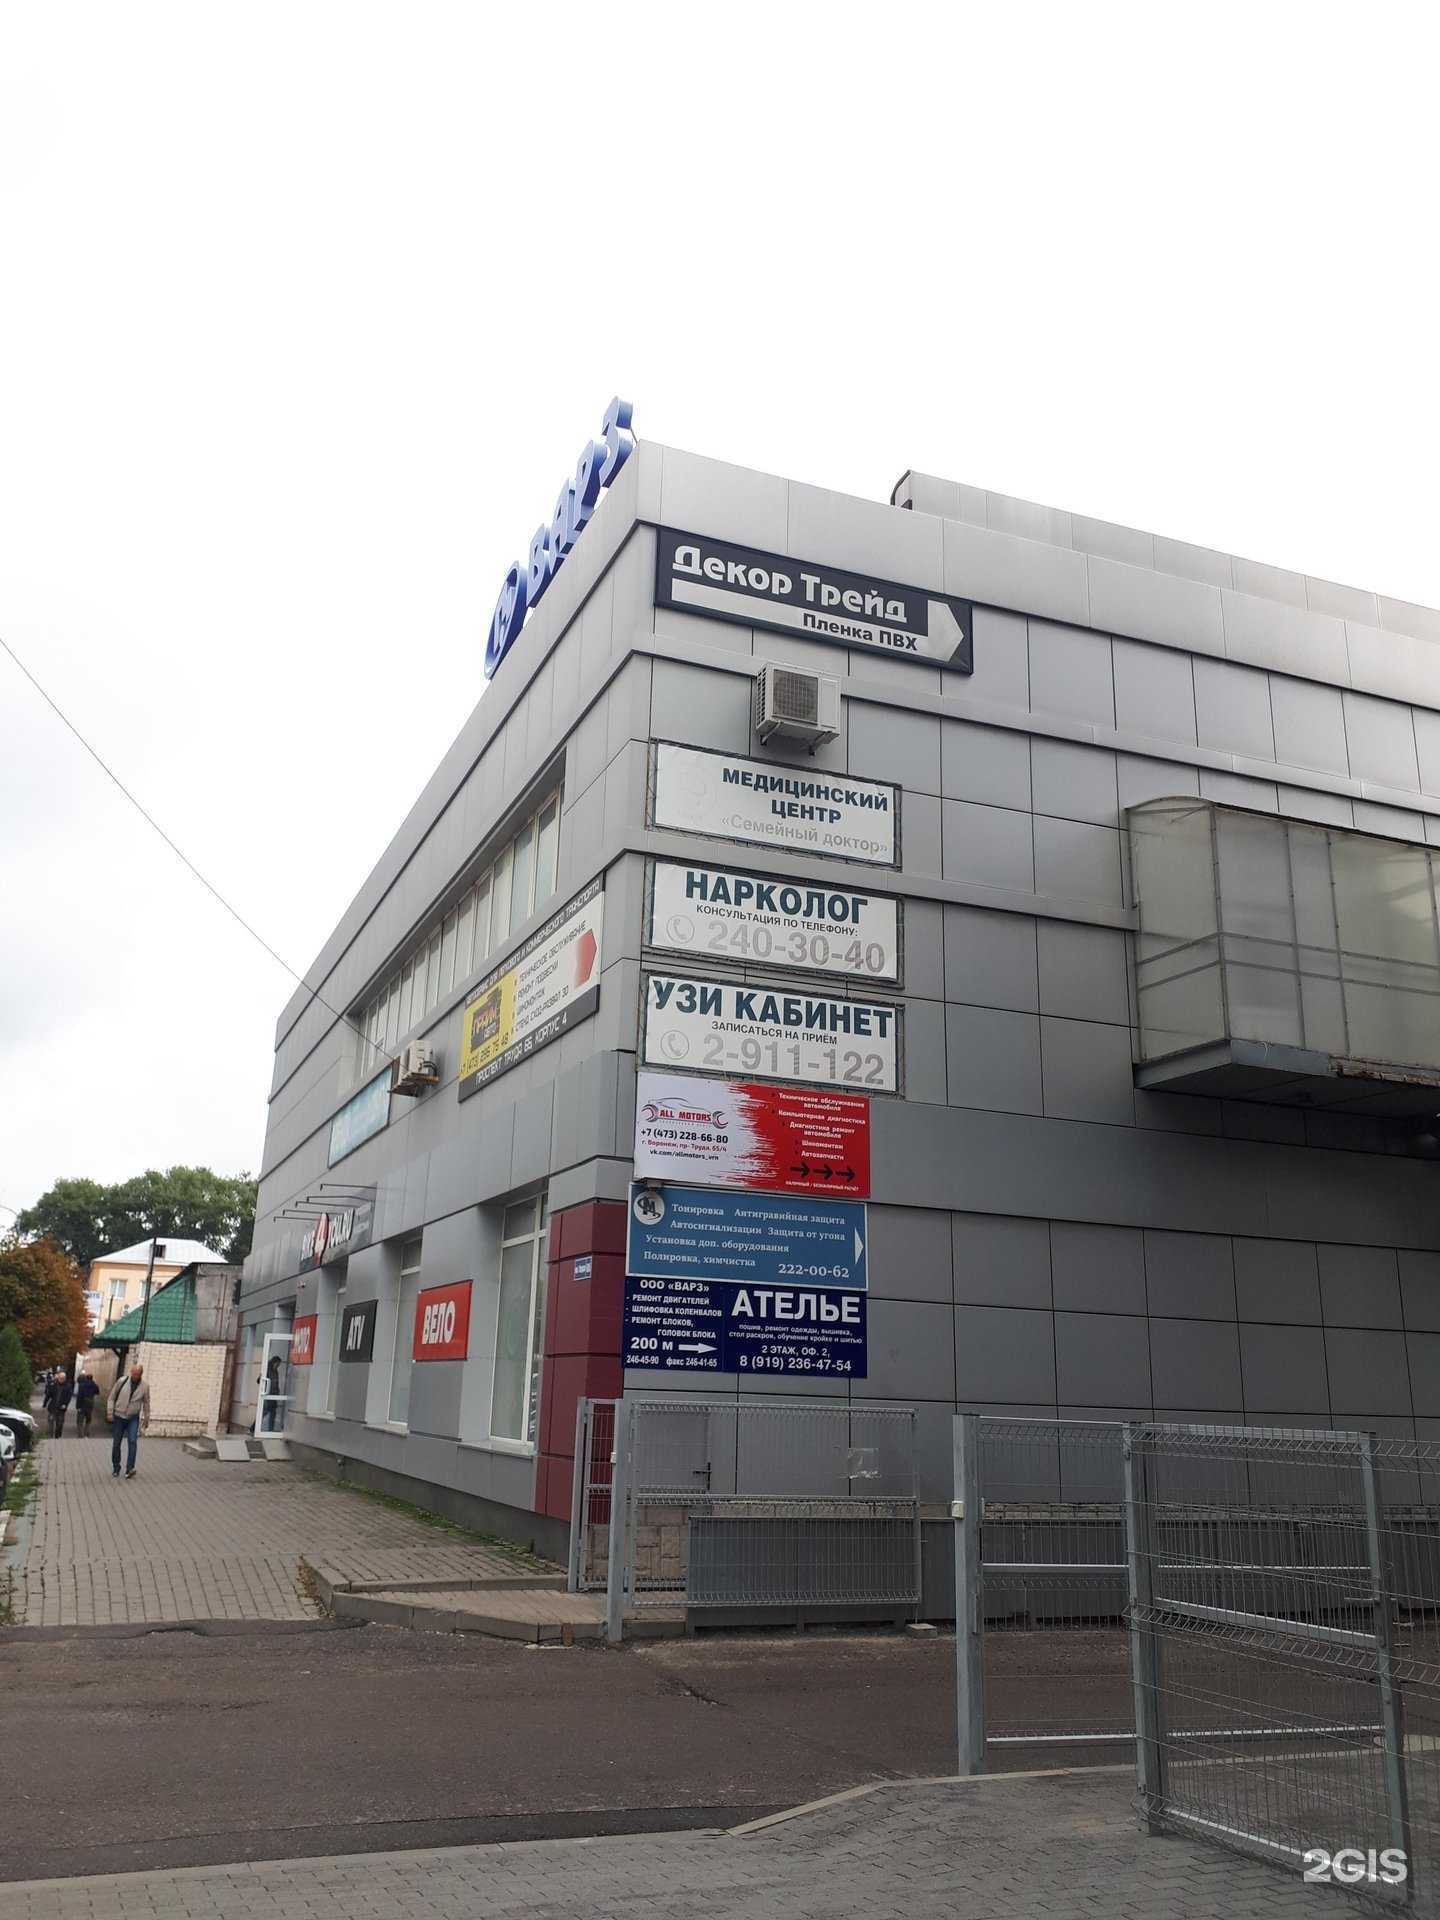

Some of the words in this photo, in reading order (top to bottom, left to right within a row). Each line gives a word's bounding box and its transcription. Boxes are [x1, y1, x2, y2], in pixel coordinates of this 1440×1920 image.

[526, 395, 633, 608] ВАРЗ
[672, 545, 792, 595] Декор
[800, 573, 907, 623] Трейд
[803, 613, 873, 642] Пленка
[879, 629, 917, 651] ПВХ
[722, 767, 888, 811] МЕДИЦИНСКИЙ
[771, 800, 842, 824] ЦЕНТР
[721, 813, 818, 842] «Семейный
[822, 831, 888, 853] доктор»
[685, 871, 868, 924] НАРКОЛОГ
[696, 905, 781, 926] КОНСУЛЬТАЦИЯ
[784, 918, 798, 928] ПО
[801, 920, 858, 937] ТЕЛЕФОНУ:
[707, 919, 885, 974] 240-30-40
[652, 980, 722, 1016] УЗИ
[735, 990, 892, 1038] КАБИНЕТ
[535, 1016, 560, 1044] КОРПУС
[562, 1012, 567, 1025] 4
[711, 1020, 782, 1038] ЗАПИСАТЬСЯ
[785, 1030, 799, 1040] НА
[703, 1033, 885, 1085] 2-911-122
[660, 1109, 674, 1118] ALL
[679, 1111, 712, 1121] MOTORS
[641, 1128, 651, 1136] +7
[653, 1130, 677, 1140] (473)
[680, 1131, 728, 1144] 228-66-80
[802, 1150, 844, 1160] Автозапчасти
[672, 1203, 724, 1216] Тонировка
[734, 1209, 808, 1221] Антигравийная
[811, 1216, 845, 1225] защита
[670, 1220, 762, 1235] Автосигнализации
[768, 1227, 804, 1237] Защита
[819, 1233, 845, 1241] угона
[646, 1234, 696, 1246] Установка
[722, 1240, 789, 1253] оборудования
[644, 1251, 700, 1264] Полировка,
[703, 1256, 755, 1266] химчистка
[778, 1263, 849, 1278] 222-00-62
[640, 1280, 665, 1289] ООО
[668, 1281, 709, 1292] «ВАРЗ»
[632, 1294, 662, 1302] РЕМОНТ
[663, 1296, 709, 1304] ДВИГАТЕЛЕЙ
[731, 1289, 860, 1323] АТЕЛЬЕ
[632, 1306, 673, 1314] ШЛИФОВКА
[675, 1308, 722, 1316] КОЛЕНВАЛОВ
[422, 1300, 455, 1344] ВЕЛО
[662, 1319, 693, 1327] БЛОКОВ,
[791, 1327, 820, 1335] одежды,
[346, 1315, 365, 1351] ATV
[631, 1337, 658, 1349] 200
[657, 1329, 690, 1337] ГОЛОВОК
[778, 1333, 809, 1341] обучение
[762, 1345, 768, 1353] 2
[770, 1346, 799, 1356] ЭТАЖ,
[801, 1347, 819, 1356] ОФ.
[822, 1348, 830, 1358] 2,
[666, 1357, 684, 1367] факс
[740, 1355, 747, 1366] 8
[751, 1355, 784, 1371] (919)
[788, 1358, 852, 1371] 236-47-54
